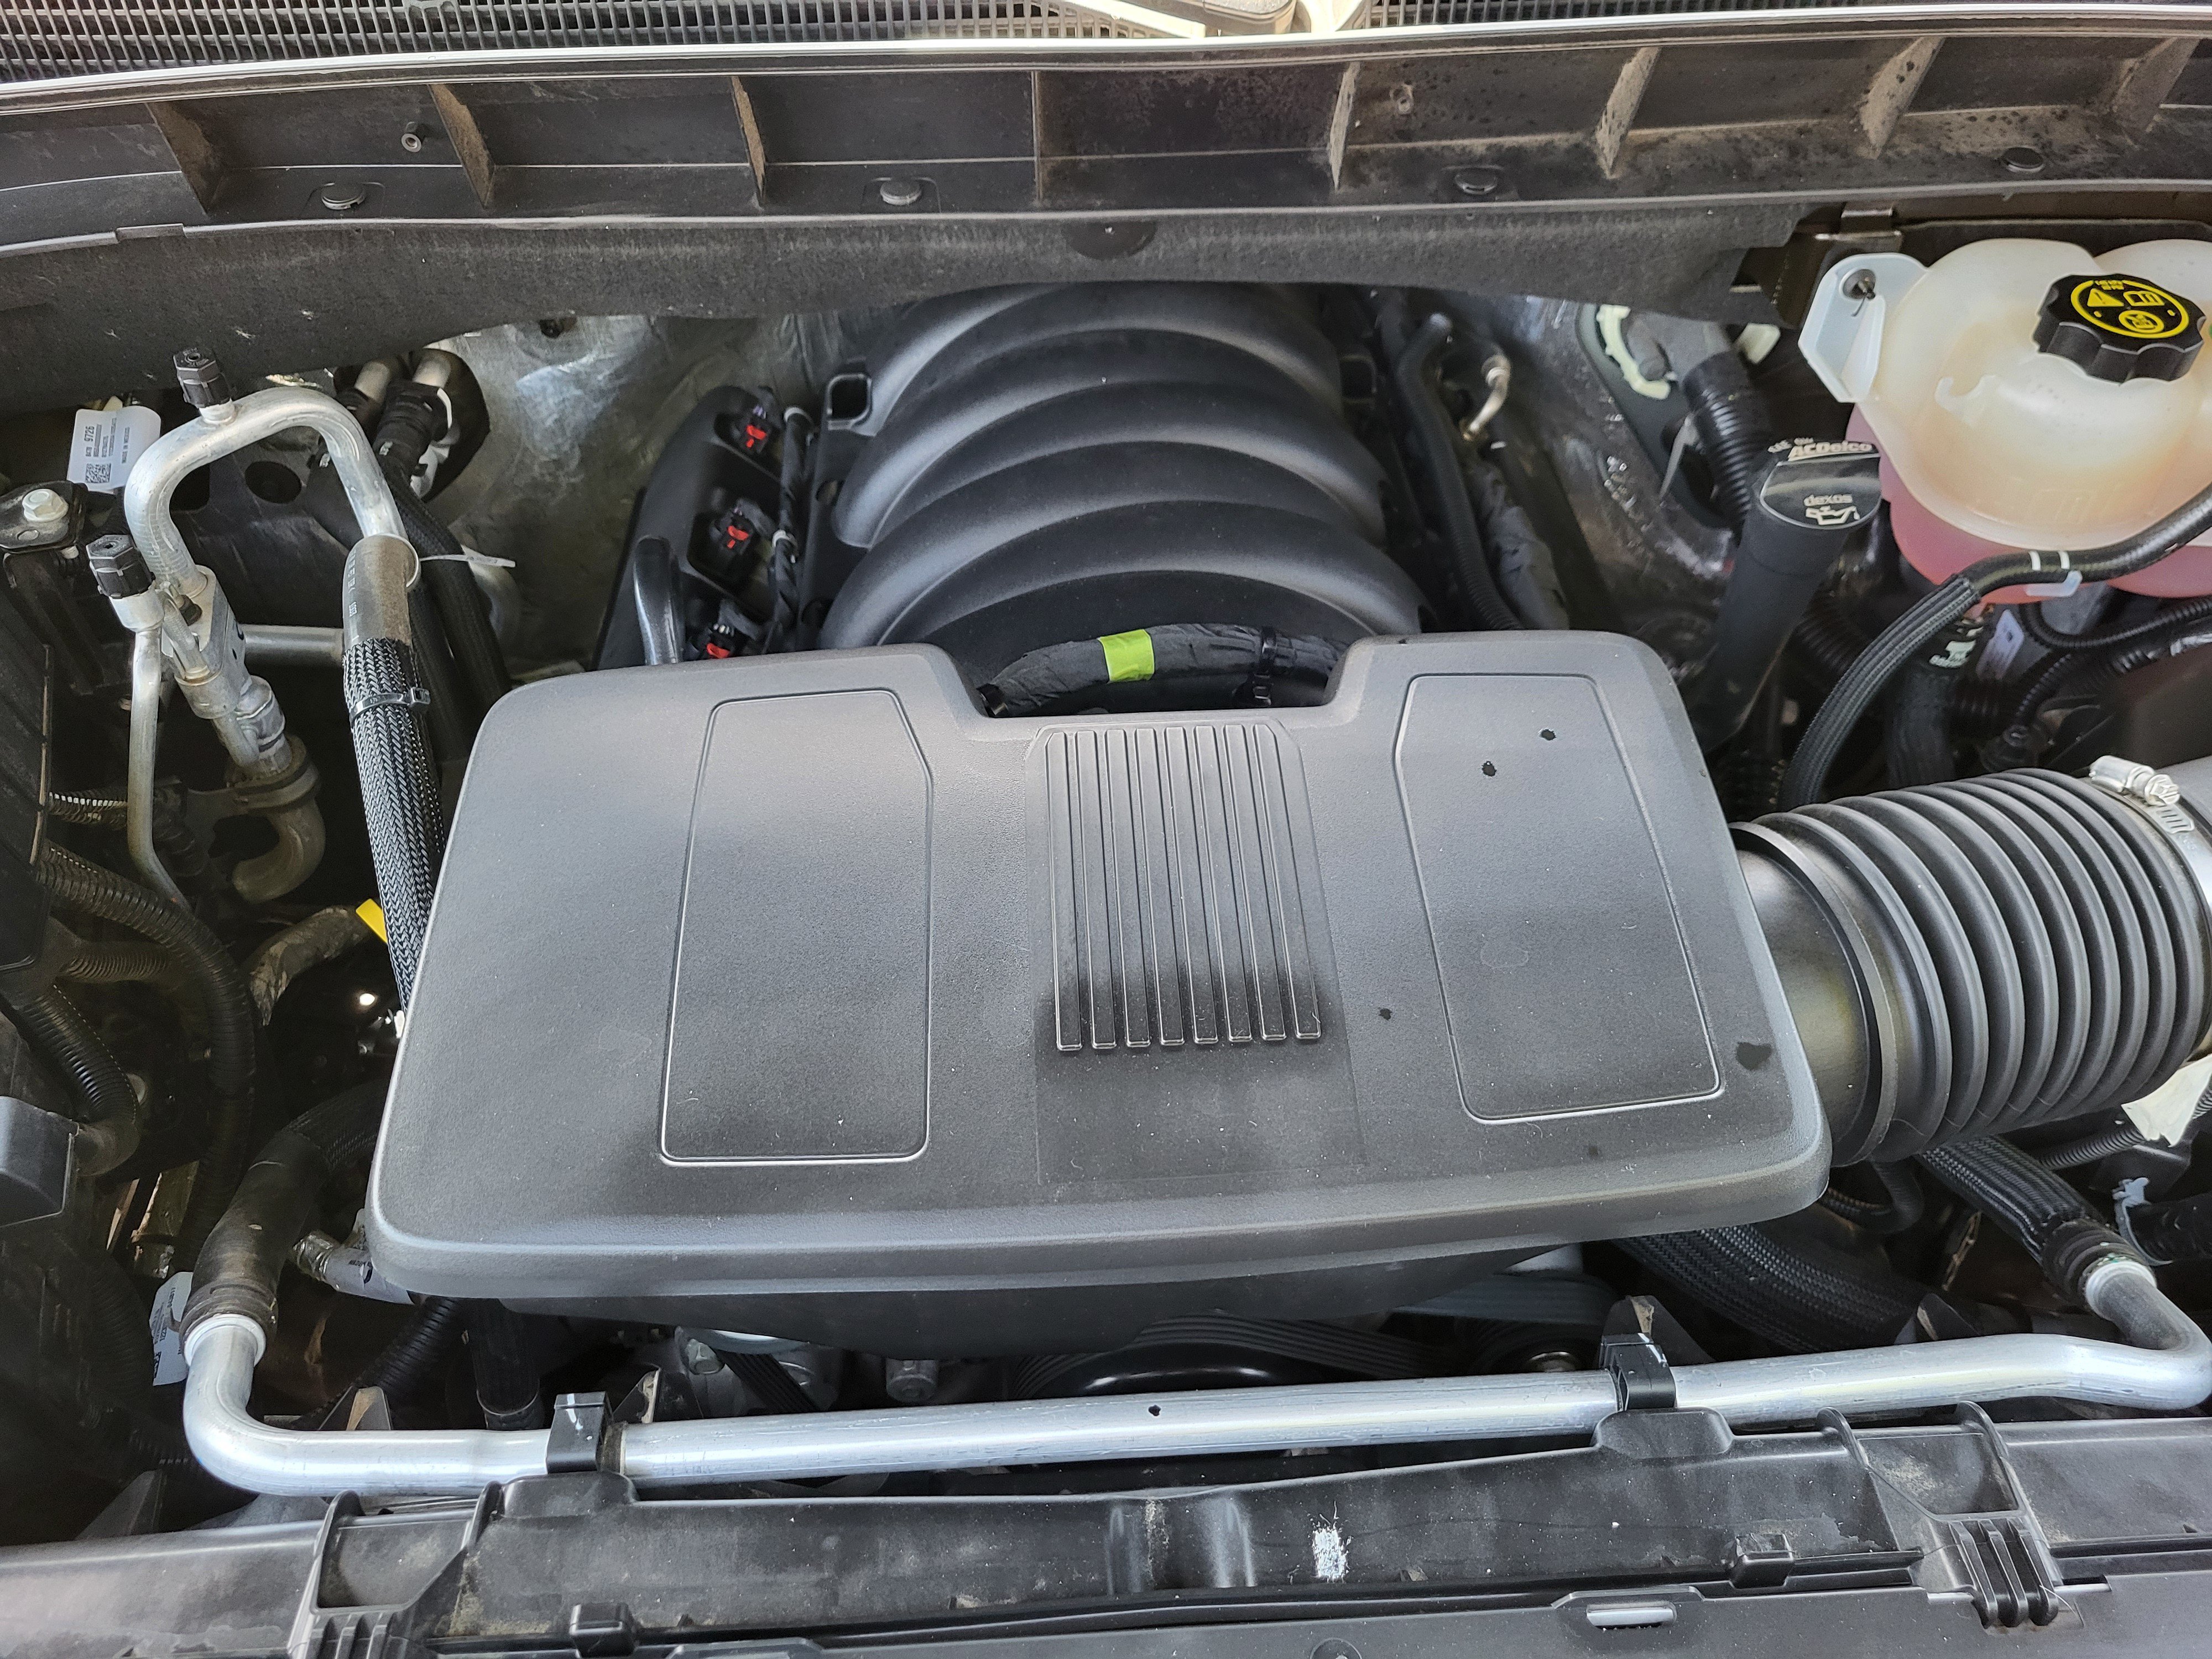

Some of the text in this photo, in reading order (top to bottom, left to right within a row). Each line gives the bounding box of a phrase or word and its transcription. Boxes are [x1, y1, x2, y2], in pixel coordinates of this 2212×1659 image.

[84, 426, 94, 442] 9726
[1788, 440, 1872, 458] ACDelco
[1804, 494, 1853, 507] dexos
